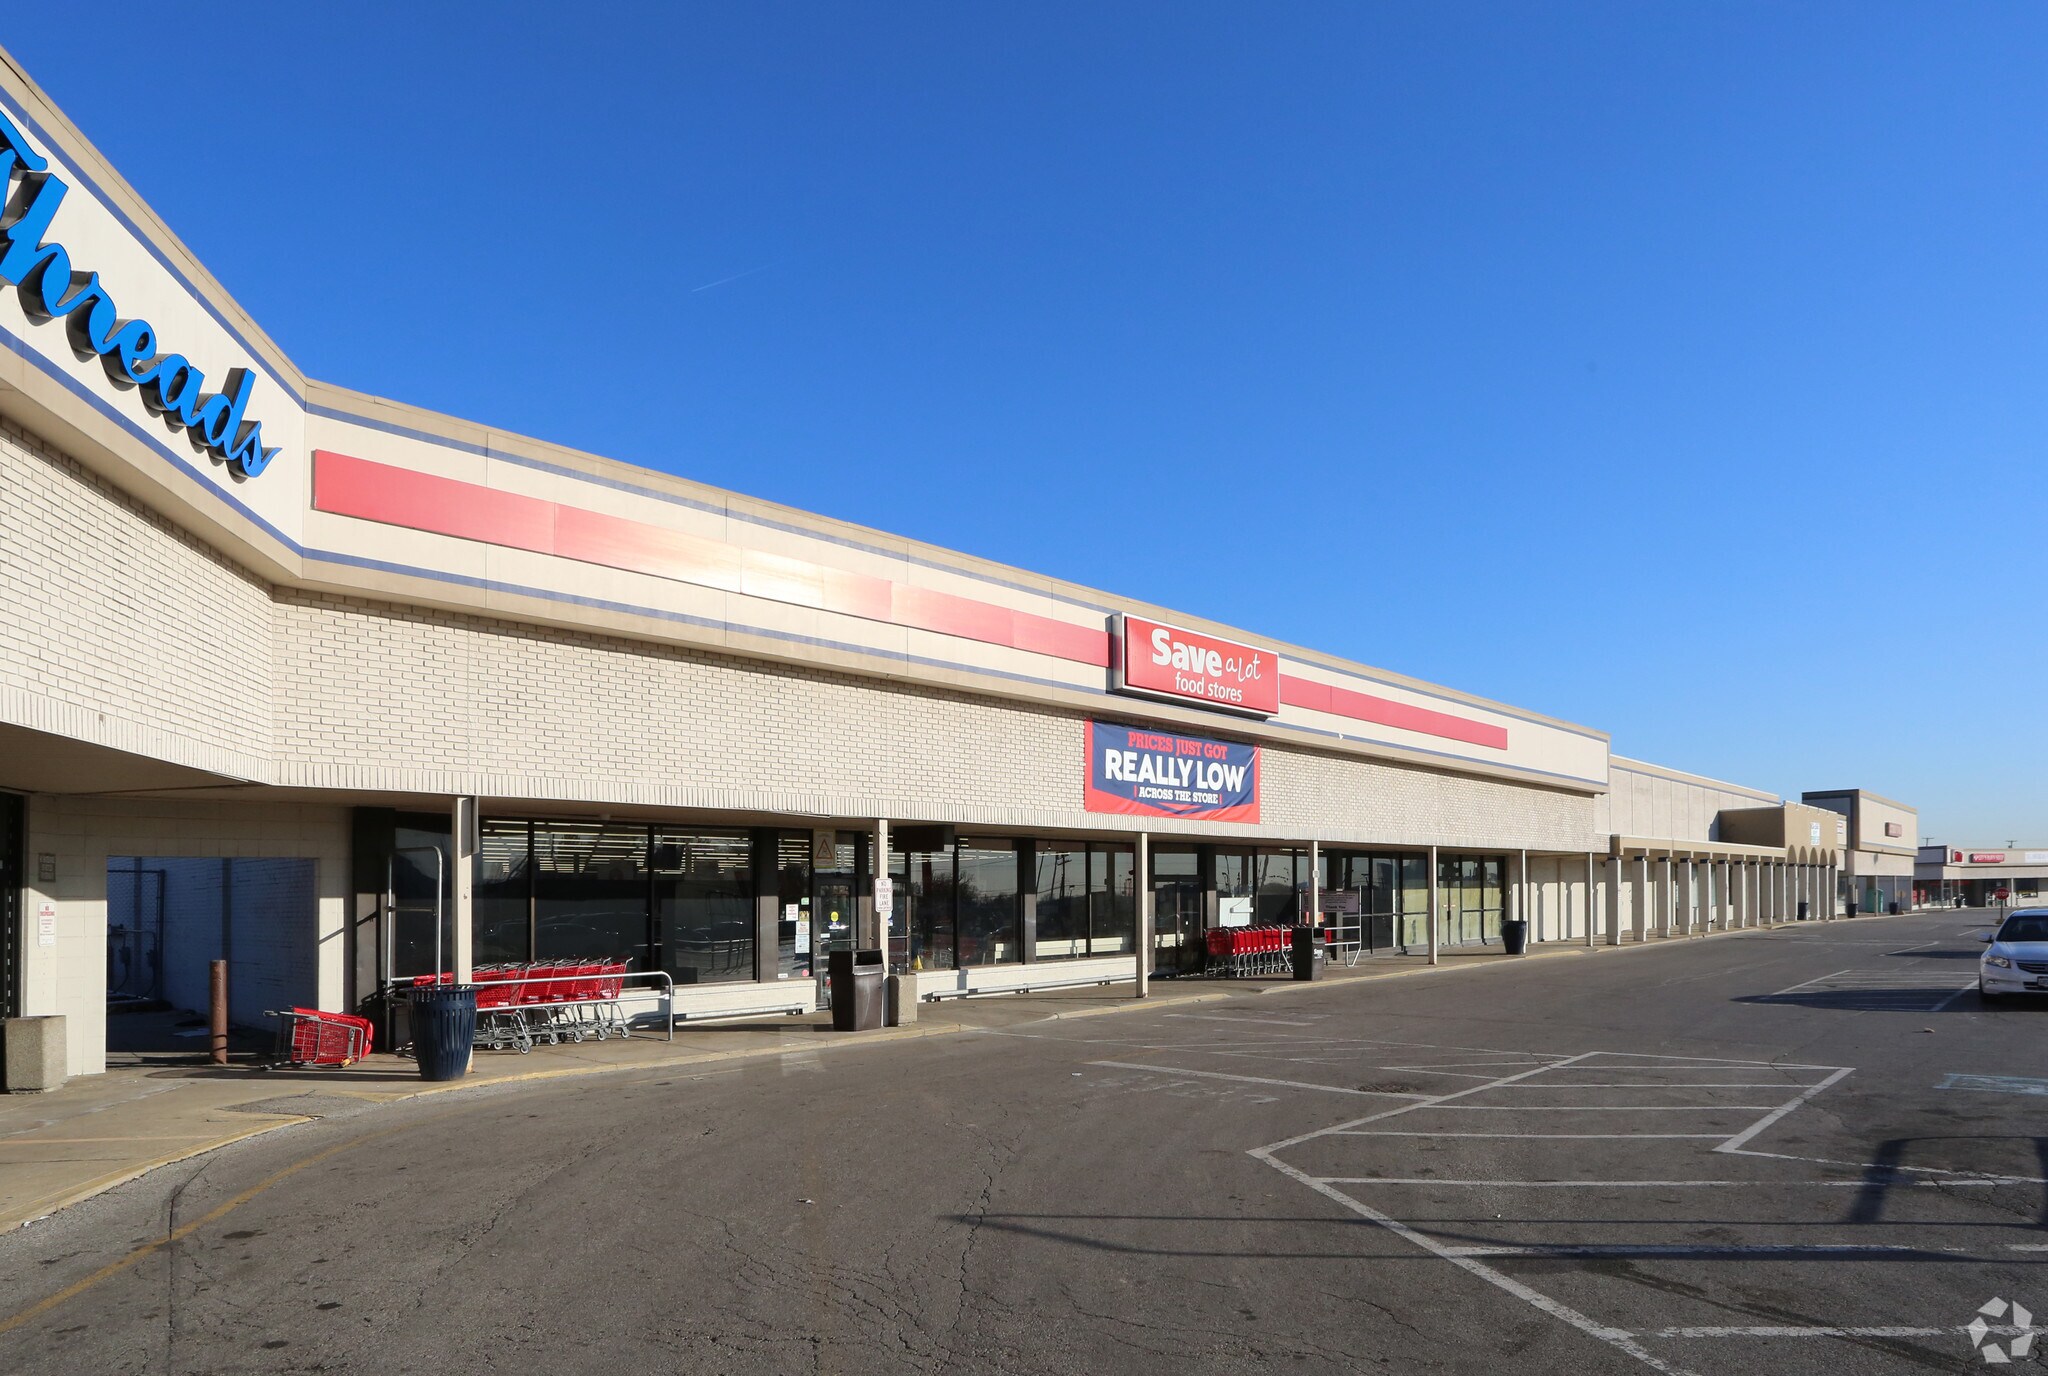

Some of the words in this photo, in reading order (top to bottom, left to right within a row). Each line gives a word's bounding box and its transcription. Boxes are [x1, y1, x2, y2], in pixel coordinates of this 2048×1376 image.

[1151, 628, 1222, 677] Save
[1225, 657, 1237, 672] a
[1175, 671, 1204, 695] food
[1207, 681, 1242, 702] stores
[1128, 731, 1174, 753] PRICES
[1175, 738, 1203, 757] JUST
[1204, 743, 1228, 760] GOT
[1105, 748, 1193, 788] REALLY
[1196, 760, 1245, 793] LOW
[1139, 786, 1173, 800] ACROSS
[1174, 789, 1192, 802] THE
[1192, 792, 1219, 805] STORE
